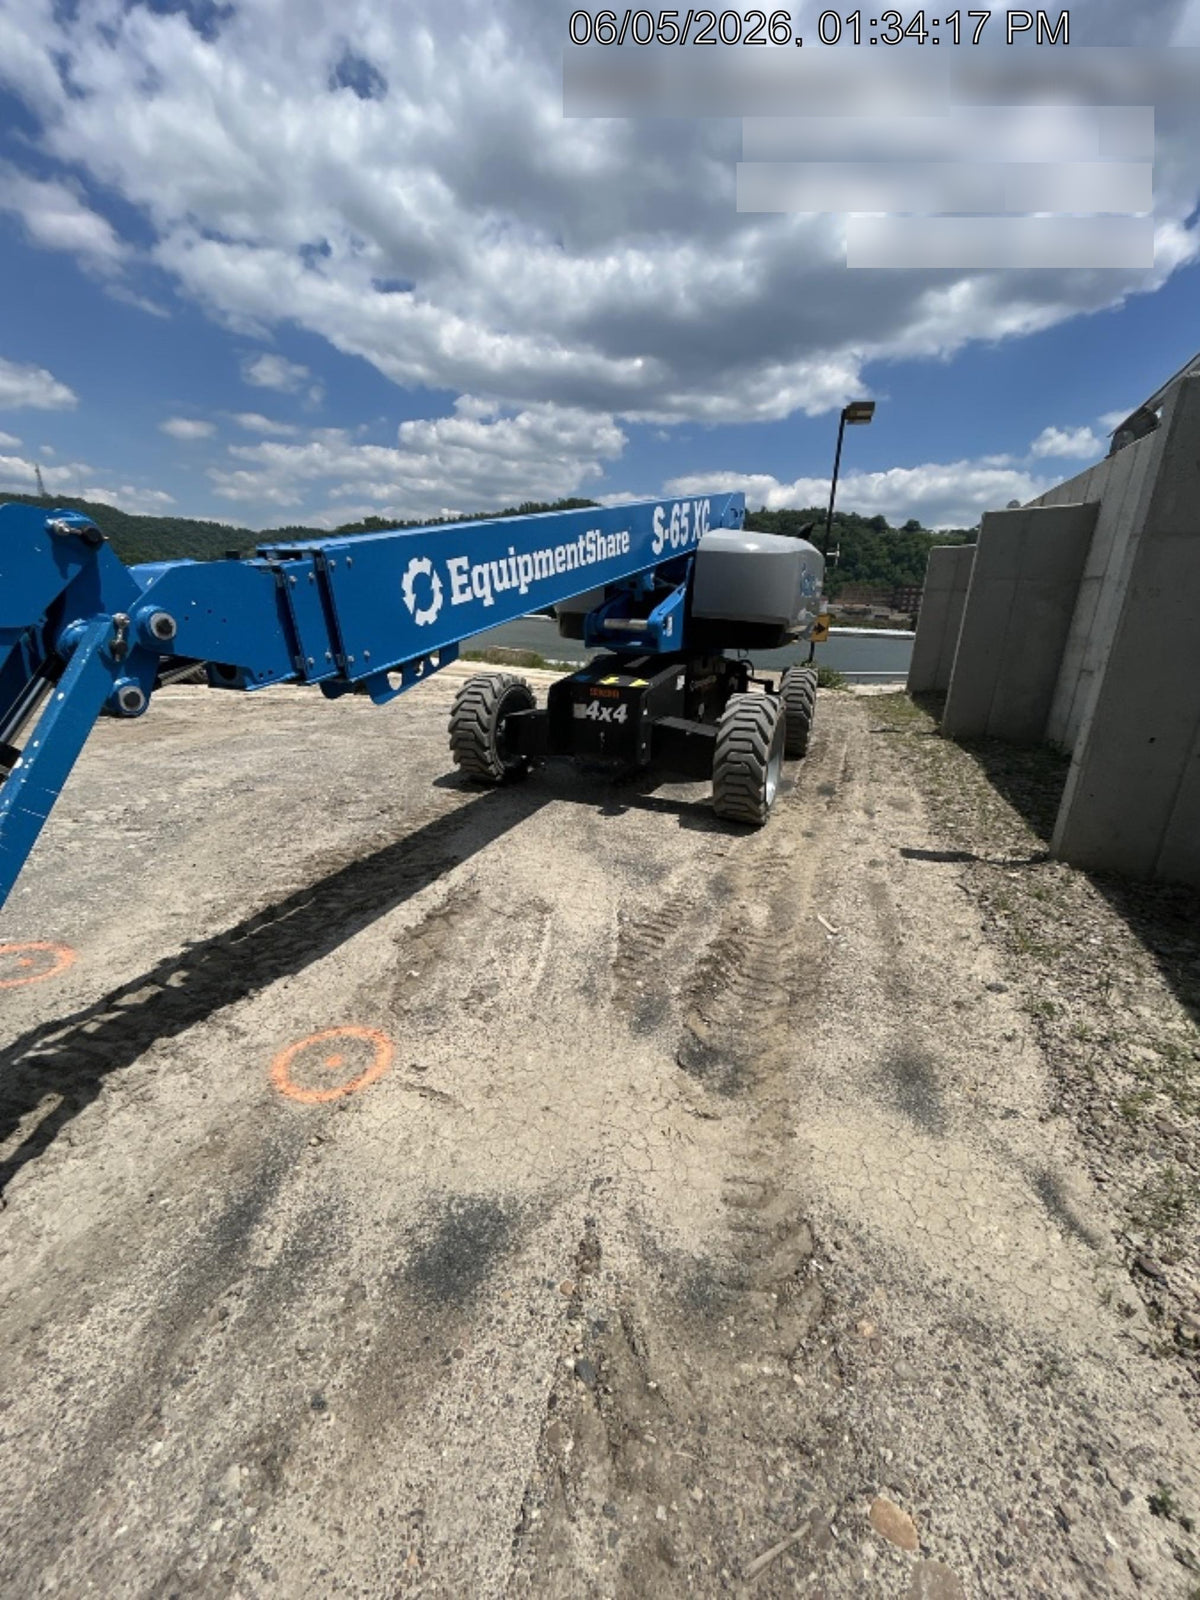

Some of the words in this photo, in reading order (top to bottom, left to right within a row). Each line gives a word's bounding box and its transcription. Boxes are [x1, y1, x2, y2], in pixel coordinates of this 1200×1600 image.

[652, 503, 690, 555] S-65
[691, 498, 711, 543] XC
[447, 529, 630, 606] EquipmentShare
[586, 699, 629, 725] 4x4
